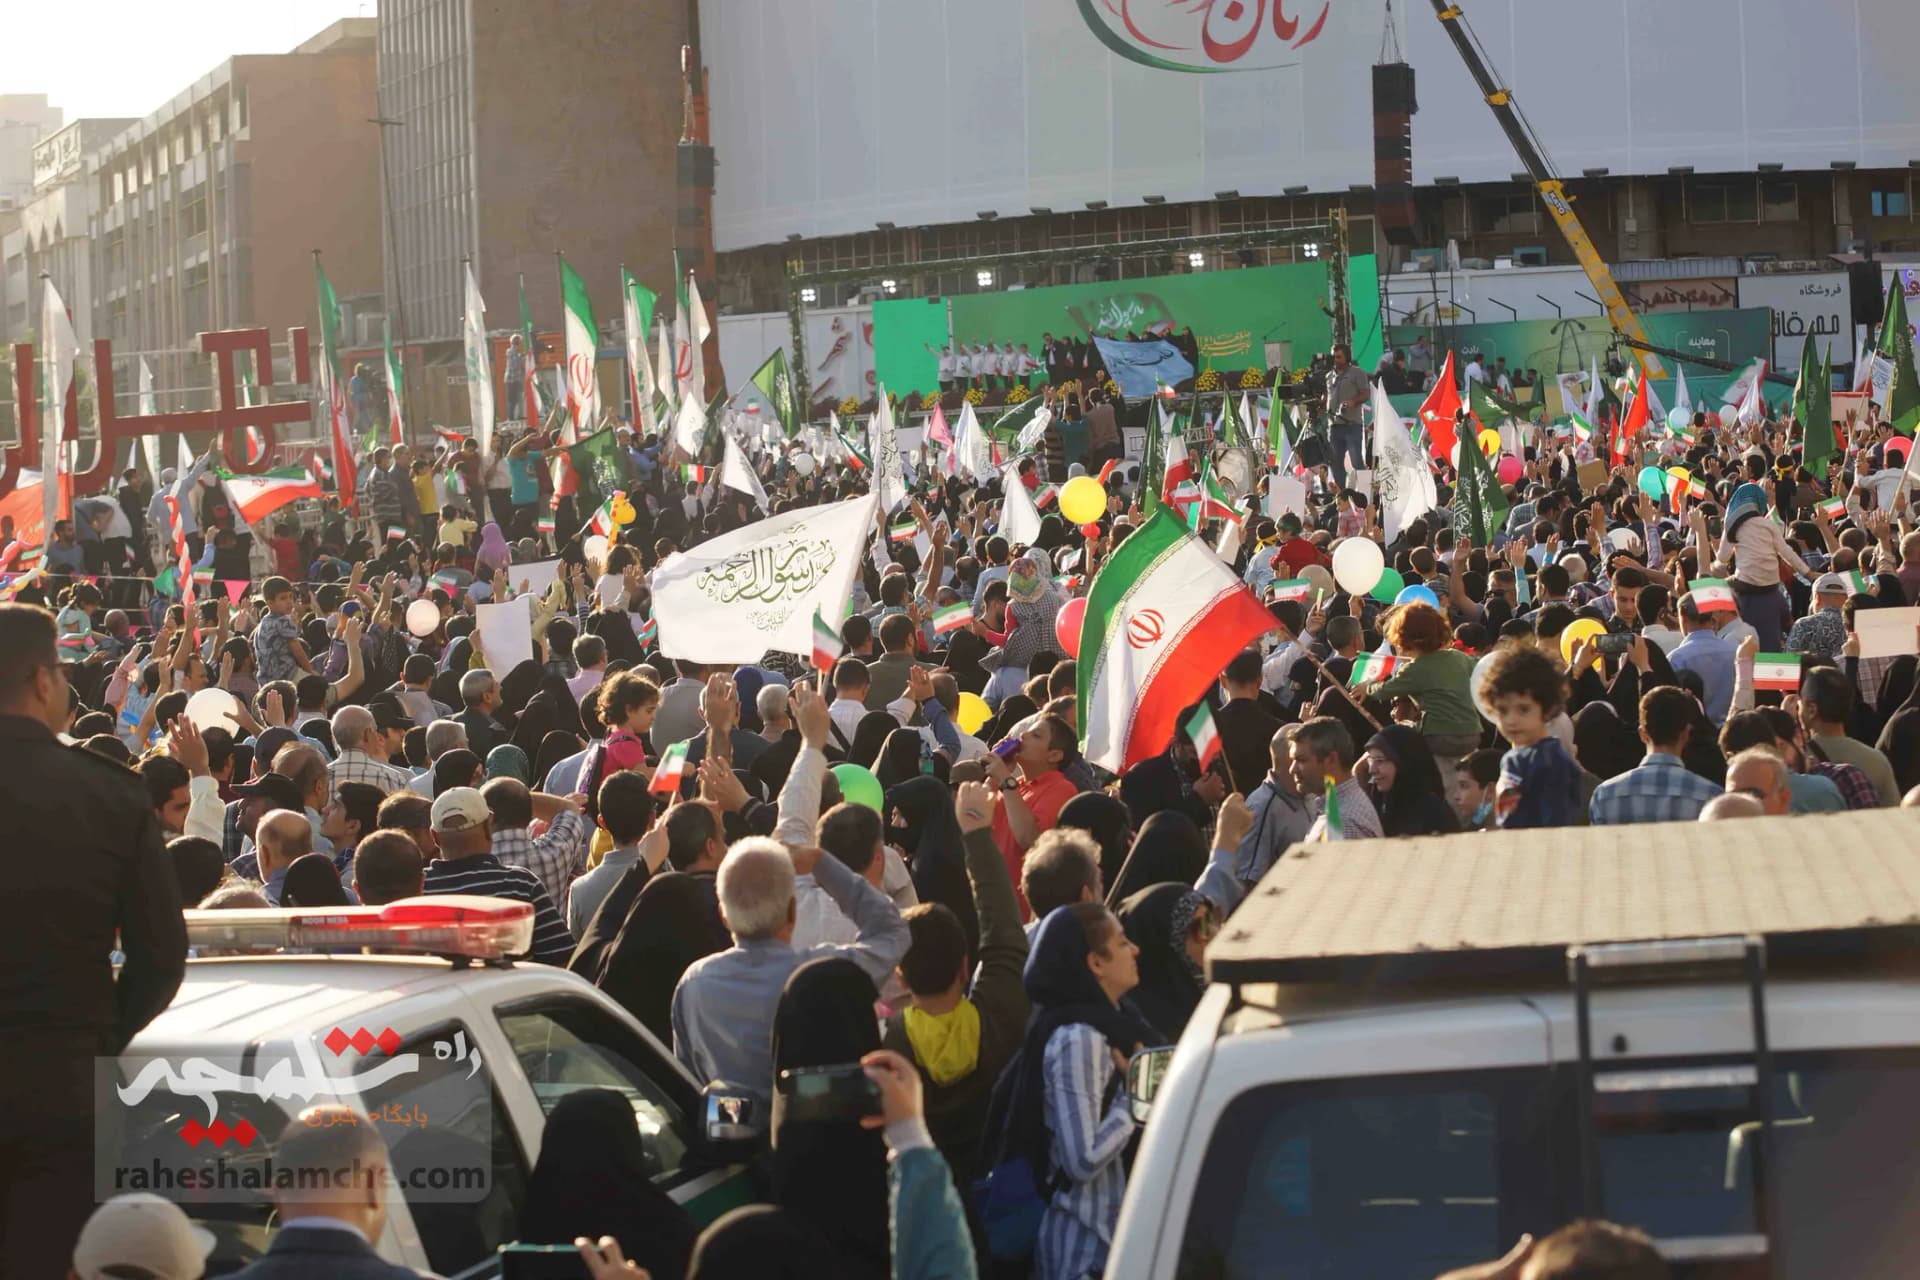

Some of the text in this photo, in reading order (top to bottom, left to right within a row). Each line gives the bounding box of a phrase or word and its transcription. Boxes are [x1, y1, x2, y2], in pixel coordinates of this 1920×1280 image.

[1548, 190, 1566, 216] KATO
[1800, 283, 1842, 297] فروشگاه
[1775, 310, 1840, 337] ممقان
[1688, 336, 1716, 349] معاینه
